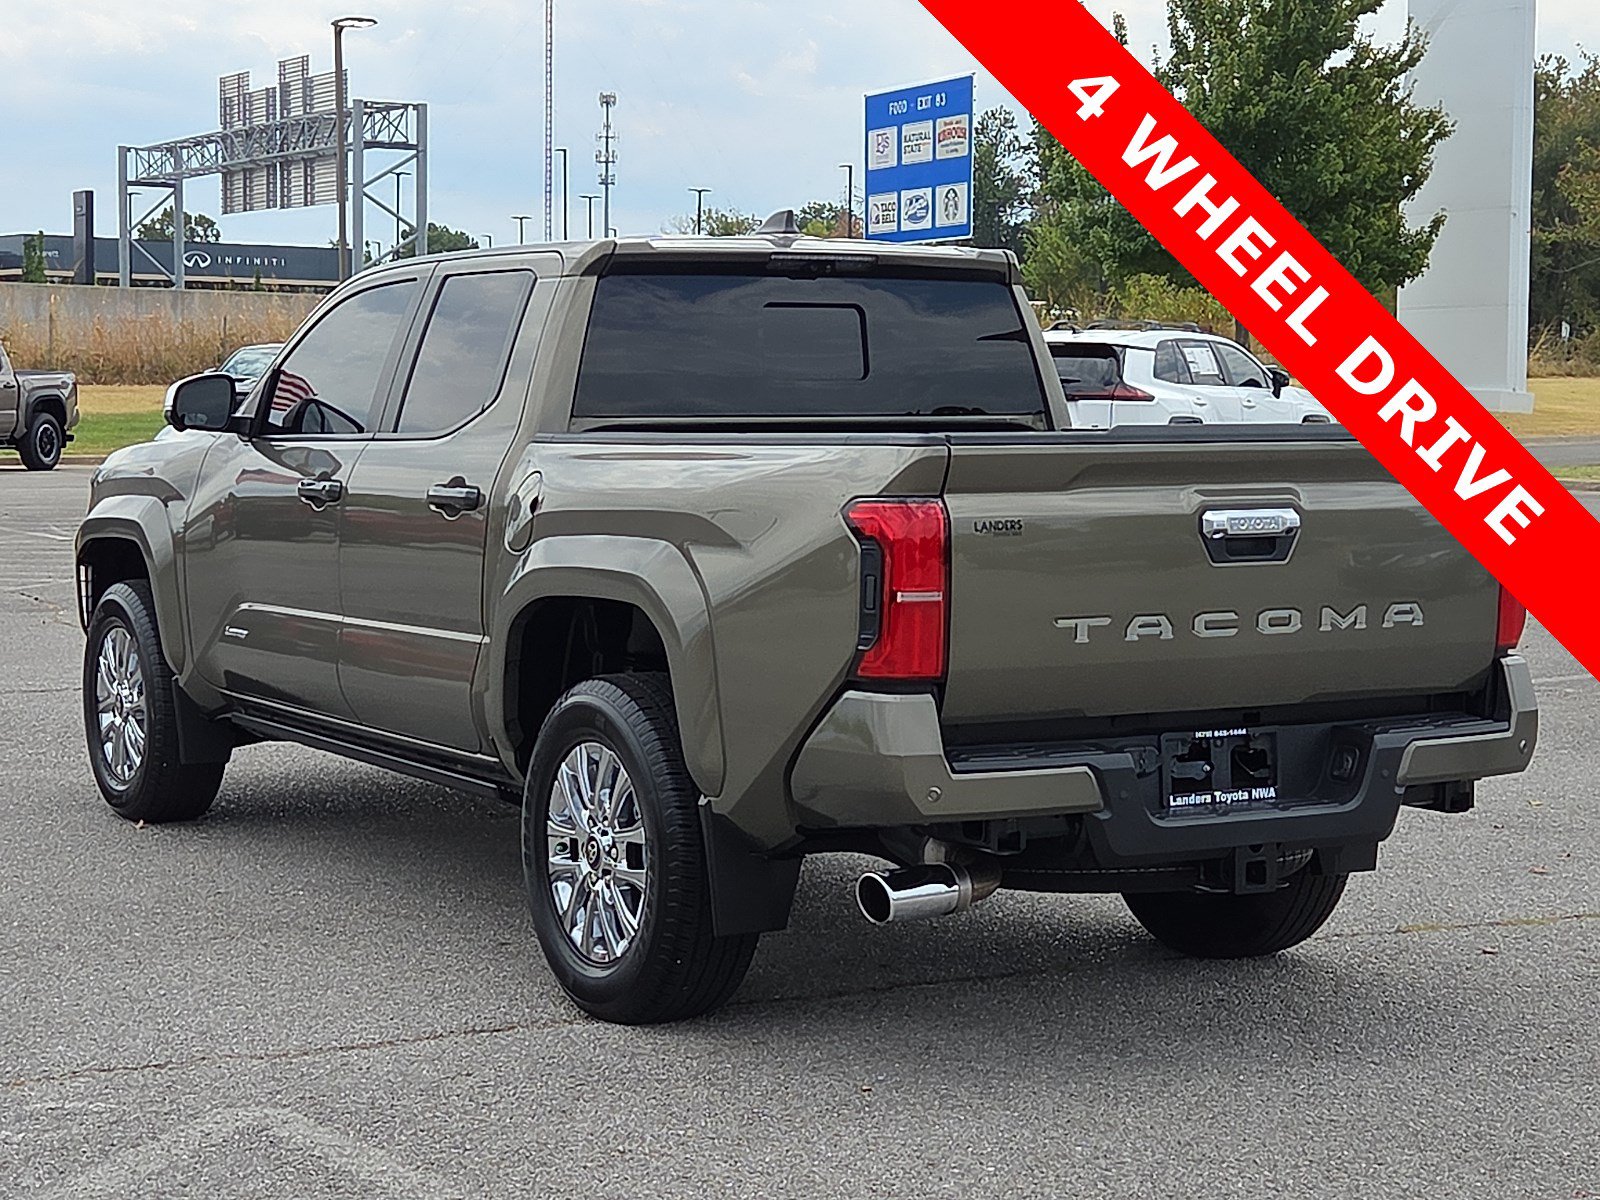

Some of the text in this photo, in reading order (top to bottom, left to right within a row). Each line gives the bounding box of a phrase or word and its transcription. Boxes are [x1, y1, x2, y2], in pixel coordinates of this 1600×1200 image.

[889, 101, 907, 115] FOOD
[917, 96, 932, 110] EXIT
[881, 201, 896, 213] TACO
[881, 212, 896, 224] BELL
[216, 256, 286, 267] INFINITI
[973, 519, 1023, 533] LANDERS
[1229, 517, 1279, 530] TOYOTA
[1053, 602, 1424, 644] TACOMA
[1169, 786, 1276, 806] Landers Toyota NWA
